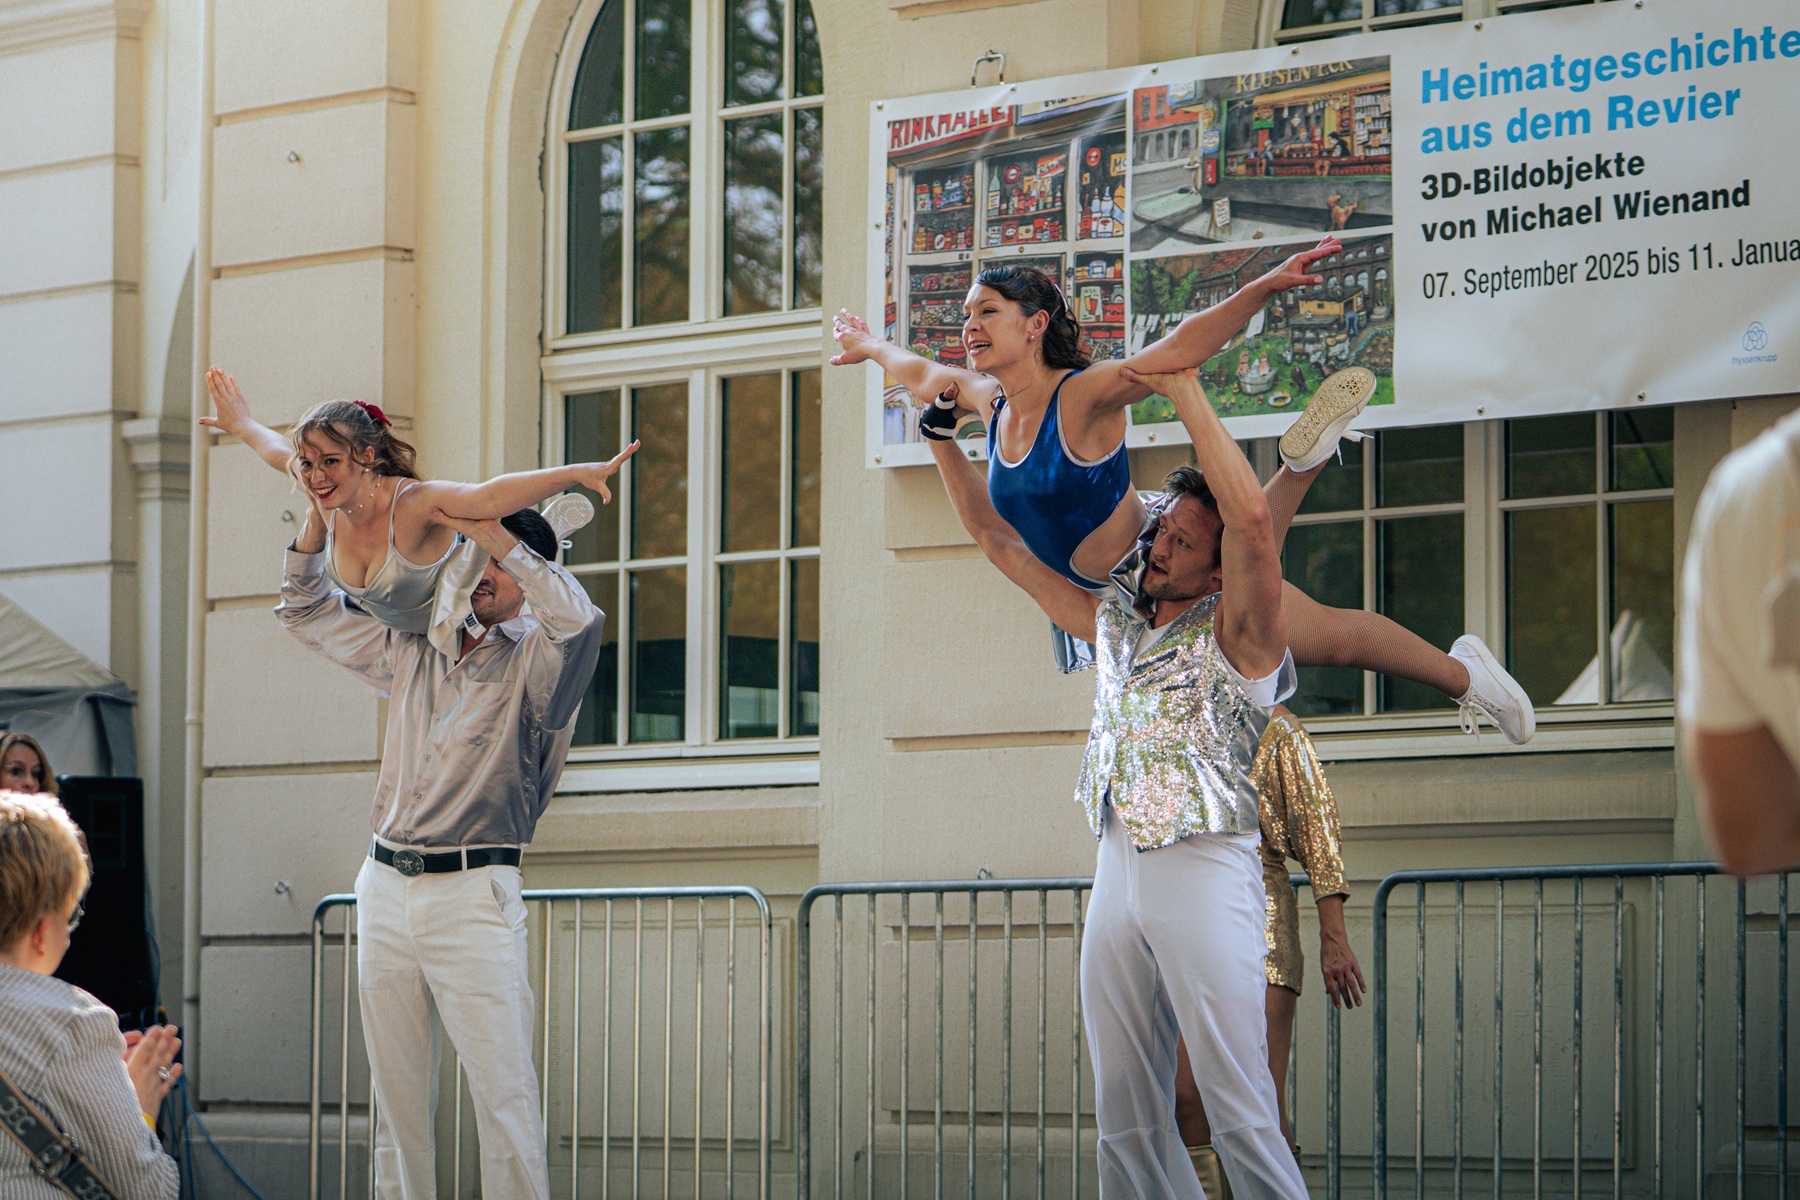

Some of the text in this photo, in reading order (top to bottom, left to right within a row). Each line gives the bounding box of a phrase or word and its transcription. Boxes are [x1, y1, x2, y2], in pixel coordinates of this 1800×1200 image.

[1421, 26, 1800, 104] Heimatgeschichte
[1420, 85, 1741, 154] aus dem Revier
[1421, 152, 1645, 200] 3D-Bildobjekte
[1421, 179, 1750, 242] von Michael Wienand
[1423, 272, 1456, 299] 07.
[1464, 260, 1578, 298] September
[1585, 250, 1639, 282] 2025
[1648, 246, 1680, 276] bis
[1688, 242, 1724, 271] 11.
